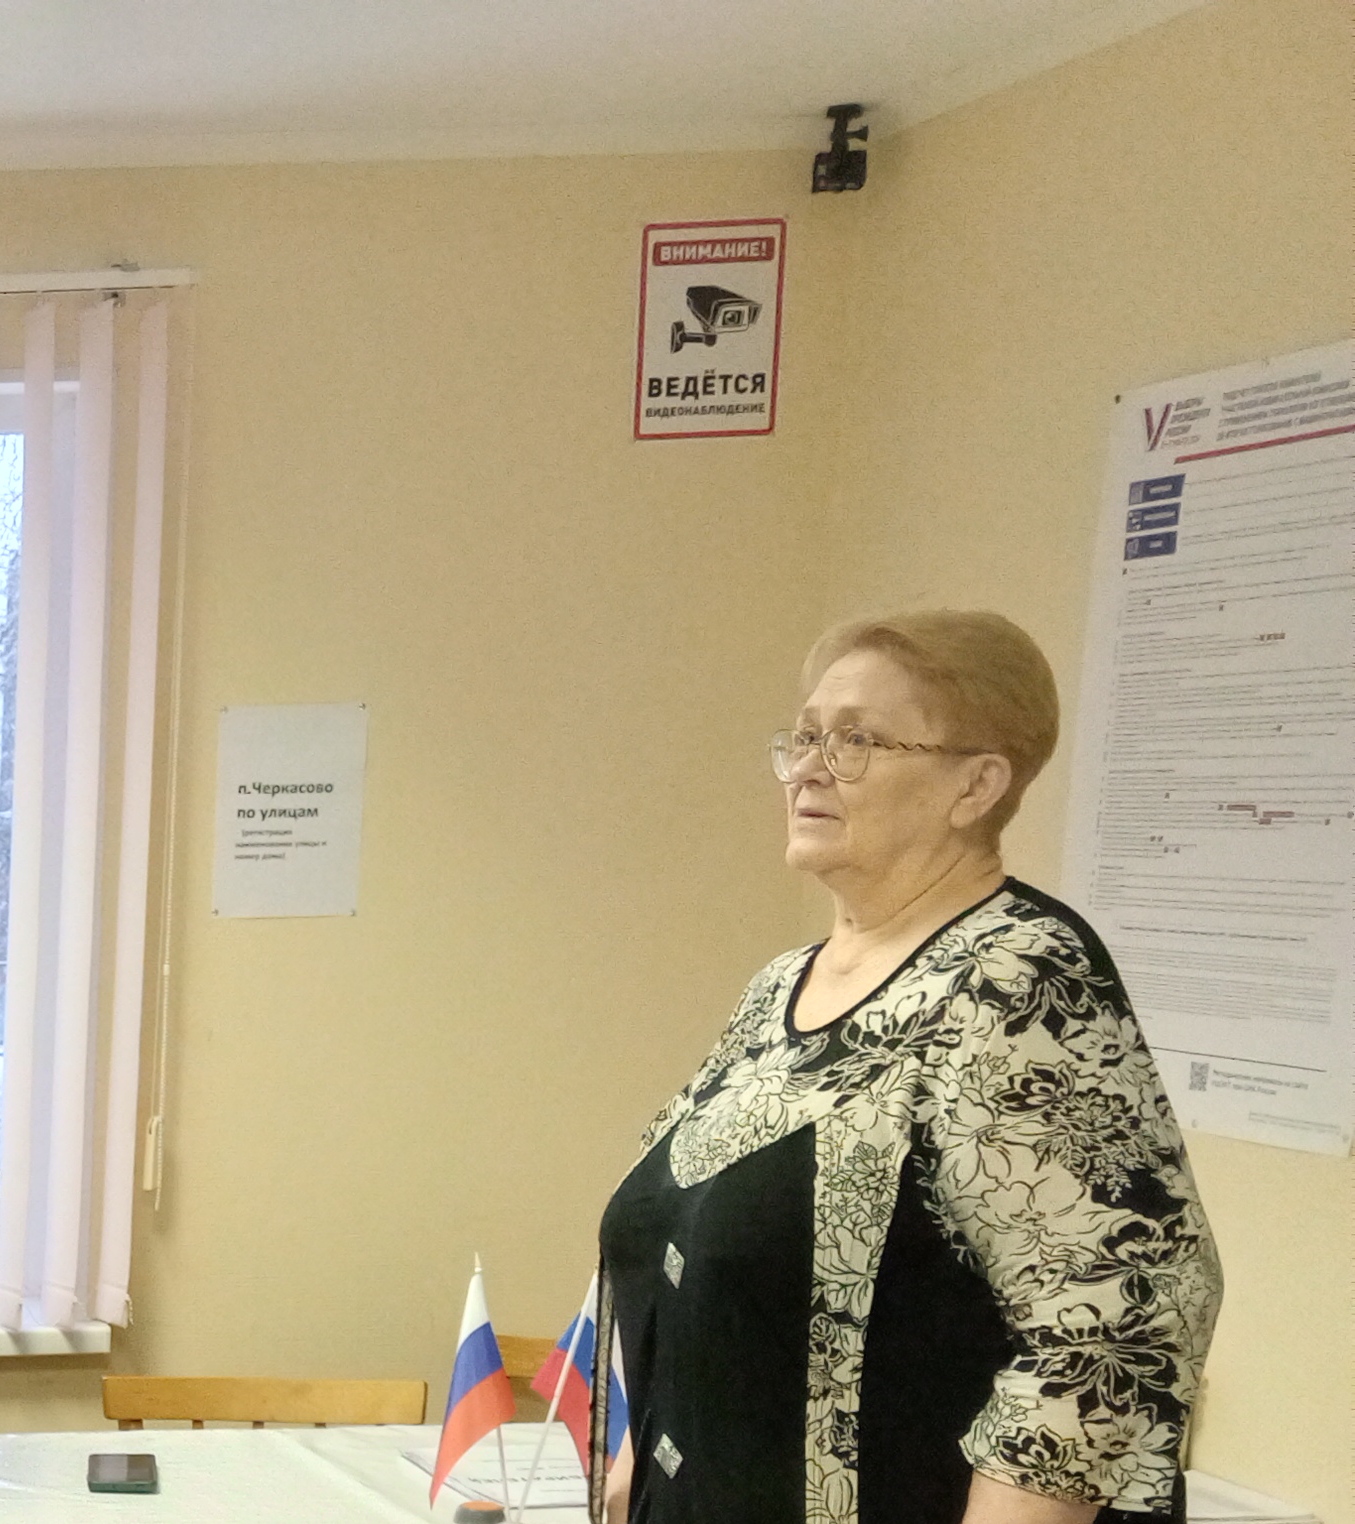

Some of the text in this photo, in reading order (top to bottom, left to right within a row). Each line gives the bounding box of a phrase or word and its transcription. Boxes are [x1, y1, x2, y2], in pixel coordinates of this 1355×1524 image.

[659, 242, 768, 262] ВНИМАНИЕ!
[647, 369, 766, 401] ВЕДЁТСЯ
[645, 403, 766, 418] ВИДЕОНАБЛЮДЕНИЕ
[237, 782, 335, 798] п.Черкасово
[237, 806, 319, 822] по улицам
